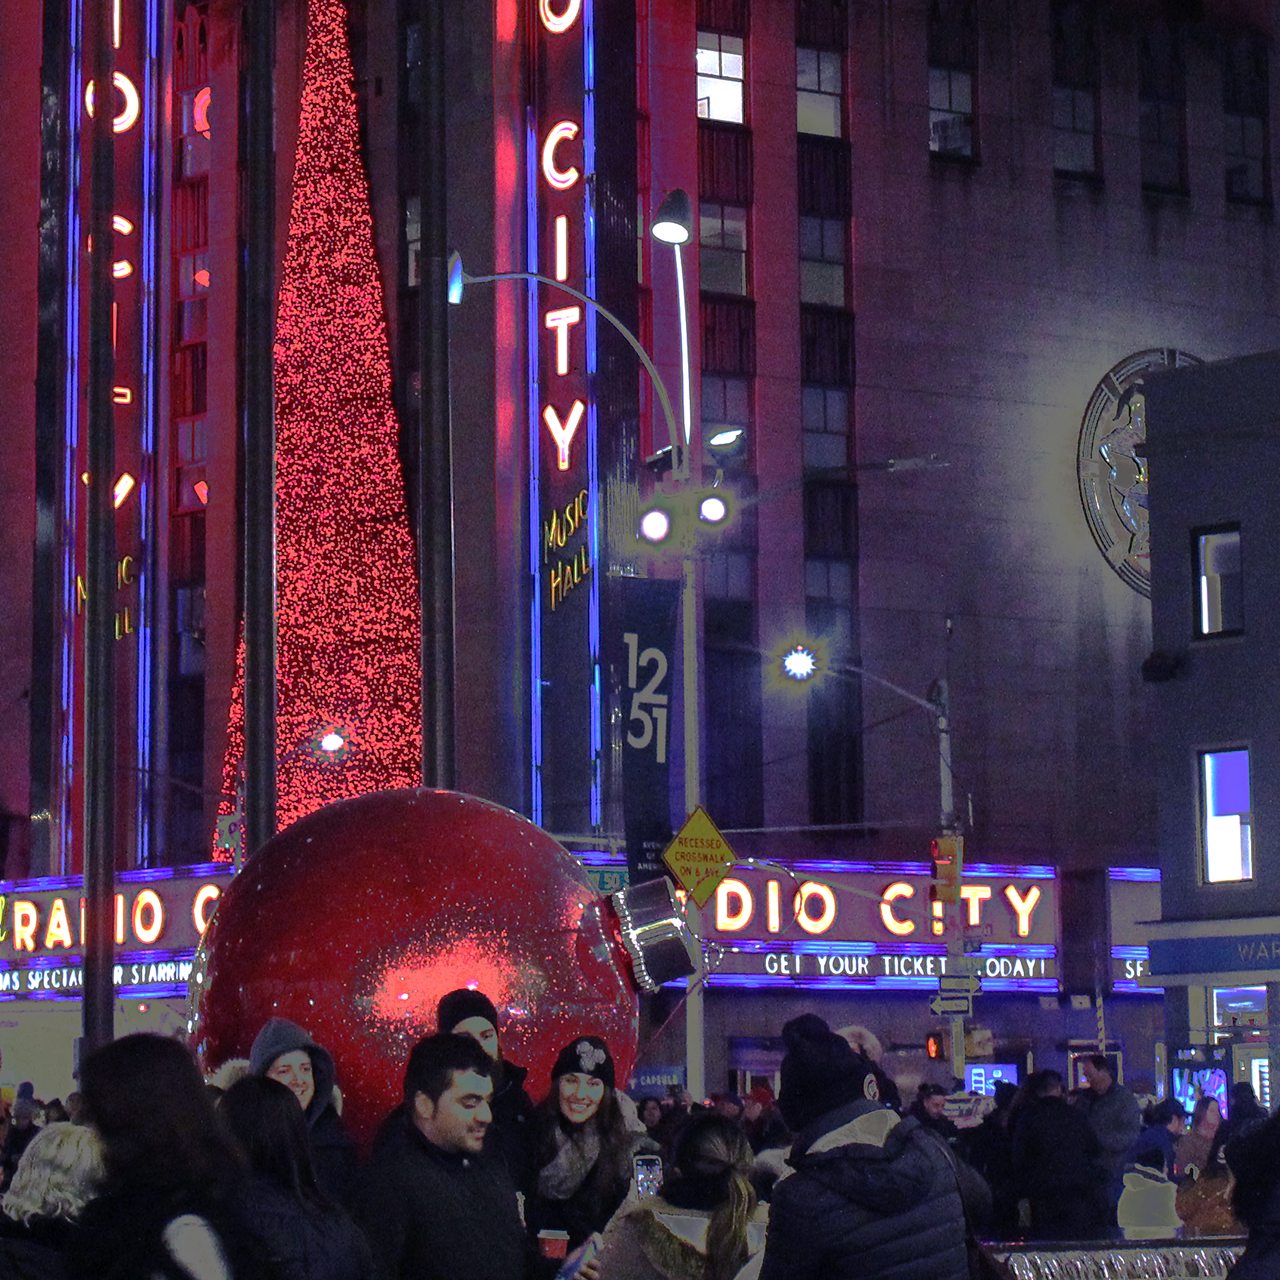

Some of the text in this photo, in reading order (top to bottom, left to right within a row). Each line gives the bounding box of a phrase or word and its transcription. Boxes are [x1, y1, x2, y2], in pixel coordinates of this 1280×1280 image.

[542, 119, 586, 471] CITY
[544, 489, 589, 564] MUSIC
[550, 545, 590, 611] HALL
[674, 851, 726, 864] CROSSWALK
[678, 837, 722, 849] RECESSED
[604, 873, 620, 889] 50
[680, 866, 721, 878] ON 6 AVE
[13, 887, 165, 953] RAIO
[879, 880, 1042, 938] CITY
[764, 954, 802, 975] GET
[818, 955, 870, 976] YOUR
[977, 956, 1046, 978] ODAY!
